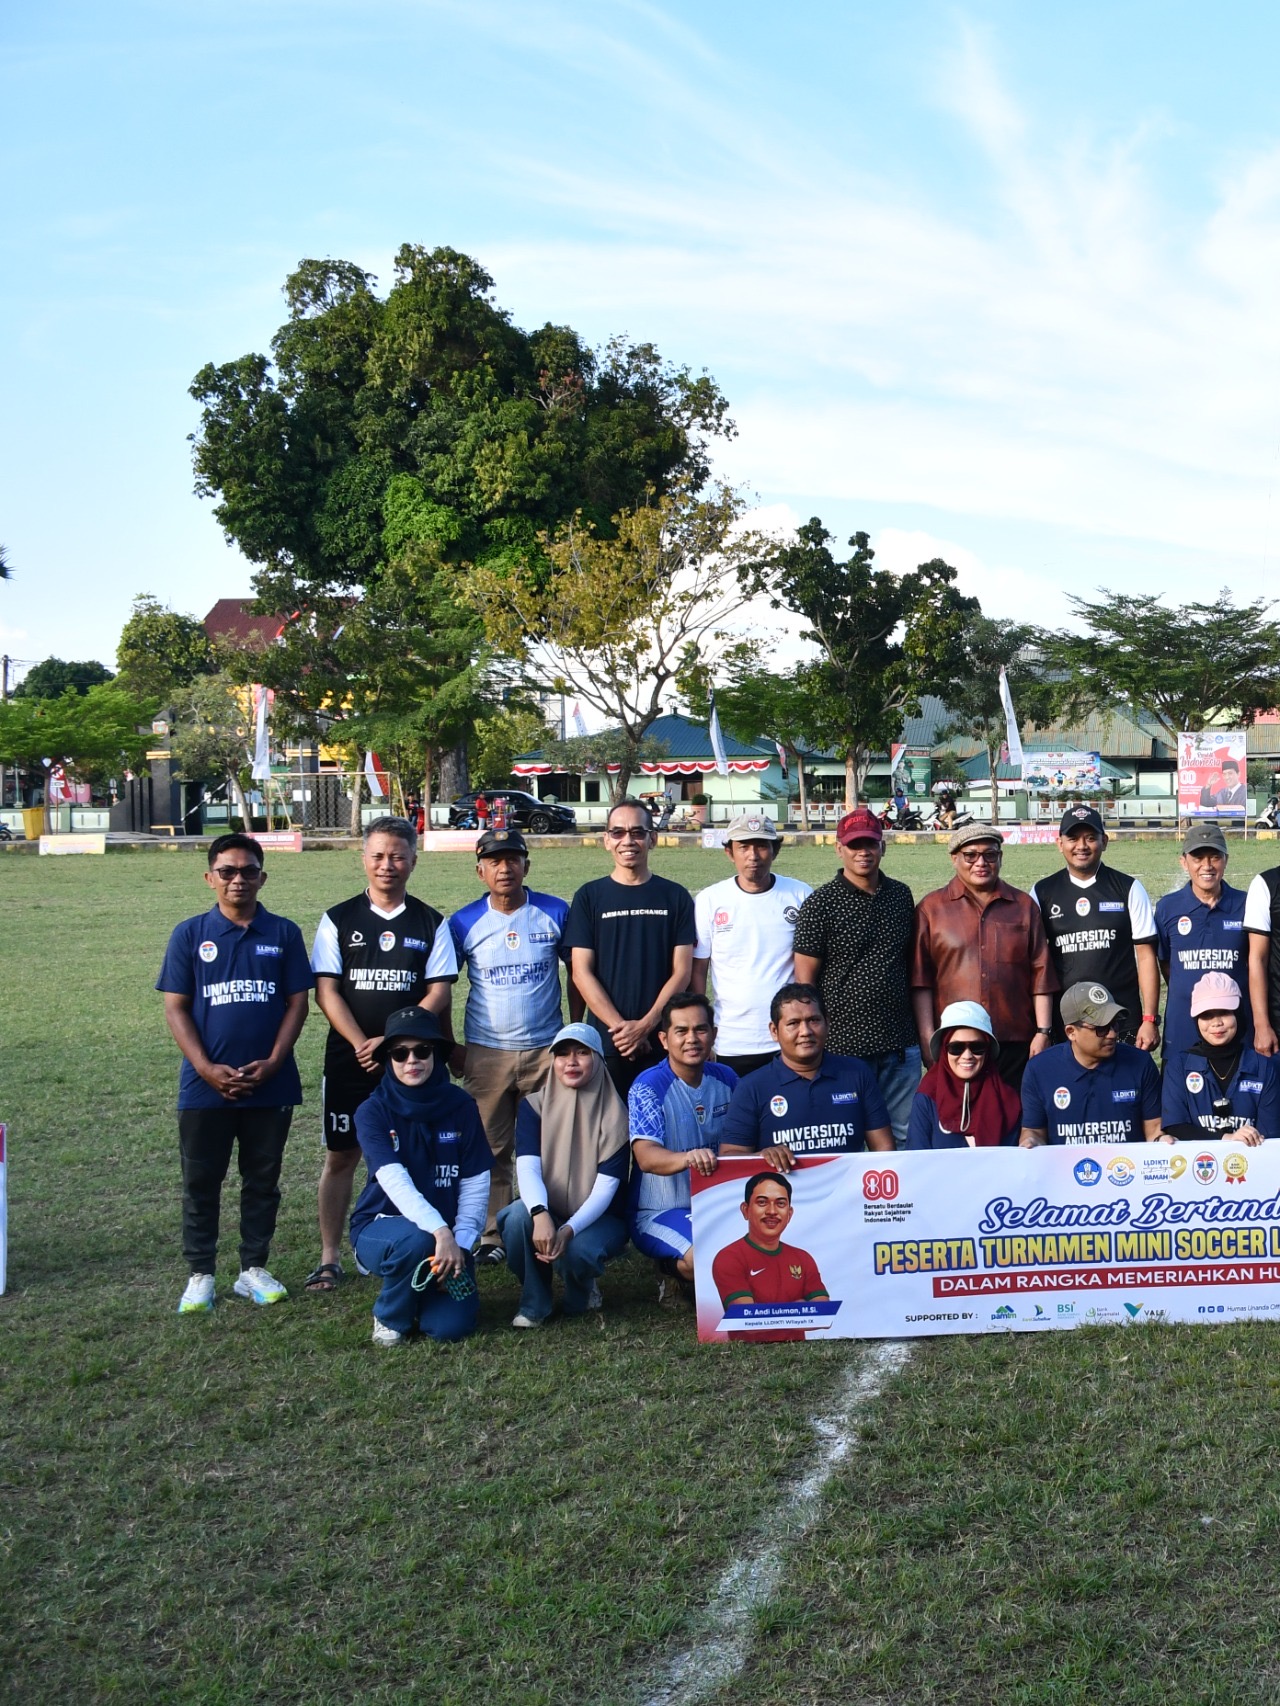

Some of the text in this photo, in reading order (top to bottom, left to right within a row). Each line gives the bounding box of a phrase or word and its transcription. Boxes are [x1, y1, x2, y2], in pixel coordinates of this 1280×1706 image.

[630, 908, 668, 917] EXCHANGE
[1055, 929, 1116, 947] UNIVERSITAS
[1061, 940, 1110, 954] ANDI DJEMMA
[1178, 949, 1239, 962] UNIVERSITAS
[484, 961, 549, 979] UNIVERSITAS
[1183, 961, 1233, 970] ANDI DJEMMA
[350, 968, 418, 984] UNIVERSITAS
[511, 974, 545, 985] DJEMMA
[203, 979, 276, 998] UNIVERSITAS
[355, 981, 411, 992] ANDI DJEMMA
[210, 992, 269, 1006] ANDI DJEMMA
[772, 1123, 854, 1144] UNIVERSITAS
[1057, 1120, 1132, 1137] UNIVERSITAS
[783, 1136, 847, 1151] NDI DJEMMA
[863, 1169, 899, 1201] 80
[979, 1197, 1130, 1234] Selamat
[874, 1237, 978, 1276] PESERTA
[979, 1231, 1111, 1269] TURNAMEN
[1116, 1228, 1171, 1263] MINI
[1175, 1224, 1266, 1261] SOCCER
[940, 1276, 1011, 1292] DALAM
[1016, 1273, 1102, 1289] RANGKA
[1107, 1267, 1254, 1286] MEMERIAHKAN
[754, 1307, 770, 1316] Andi
[772, 1307, 801, 1316] Lukman,
[1057, 1303, 1074, 1313] BSI
[1144, 1309, 1165, 1317] VALE
[905, 1313, 960, 1323] SUPPORTED
[962, 1312, 973, 1320] BY
